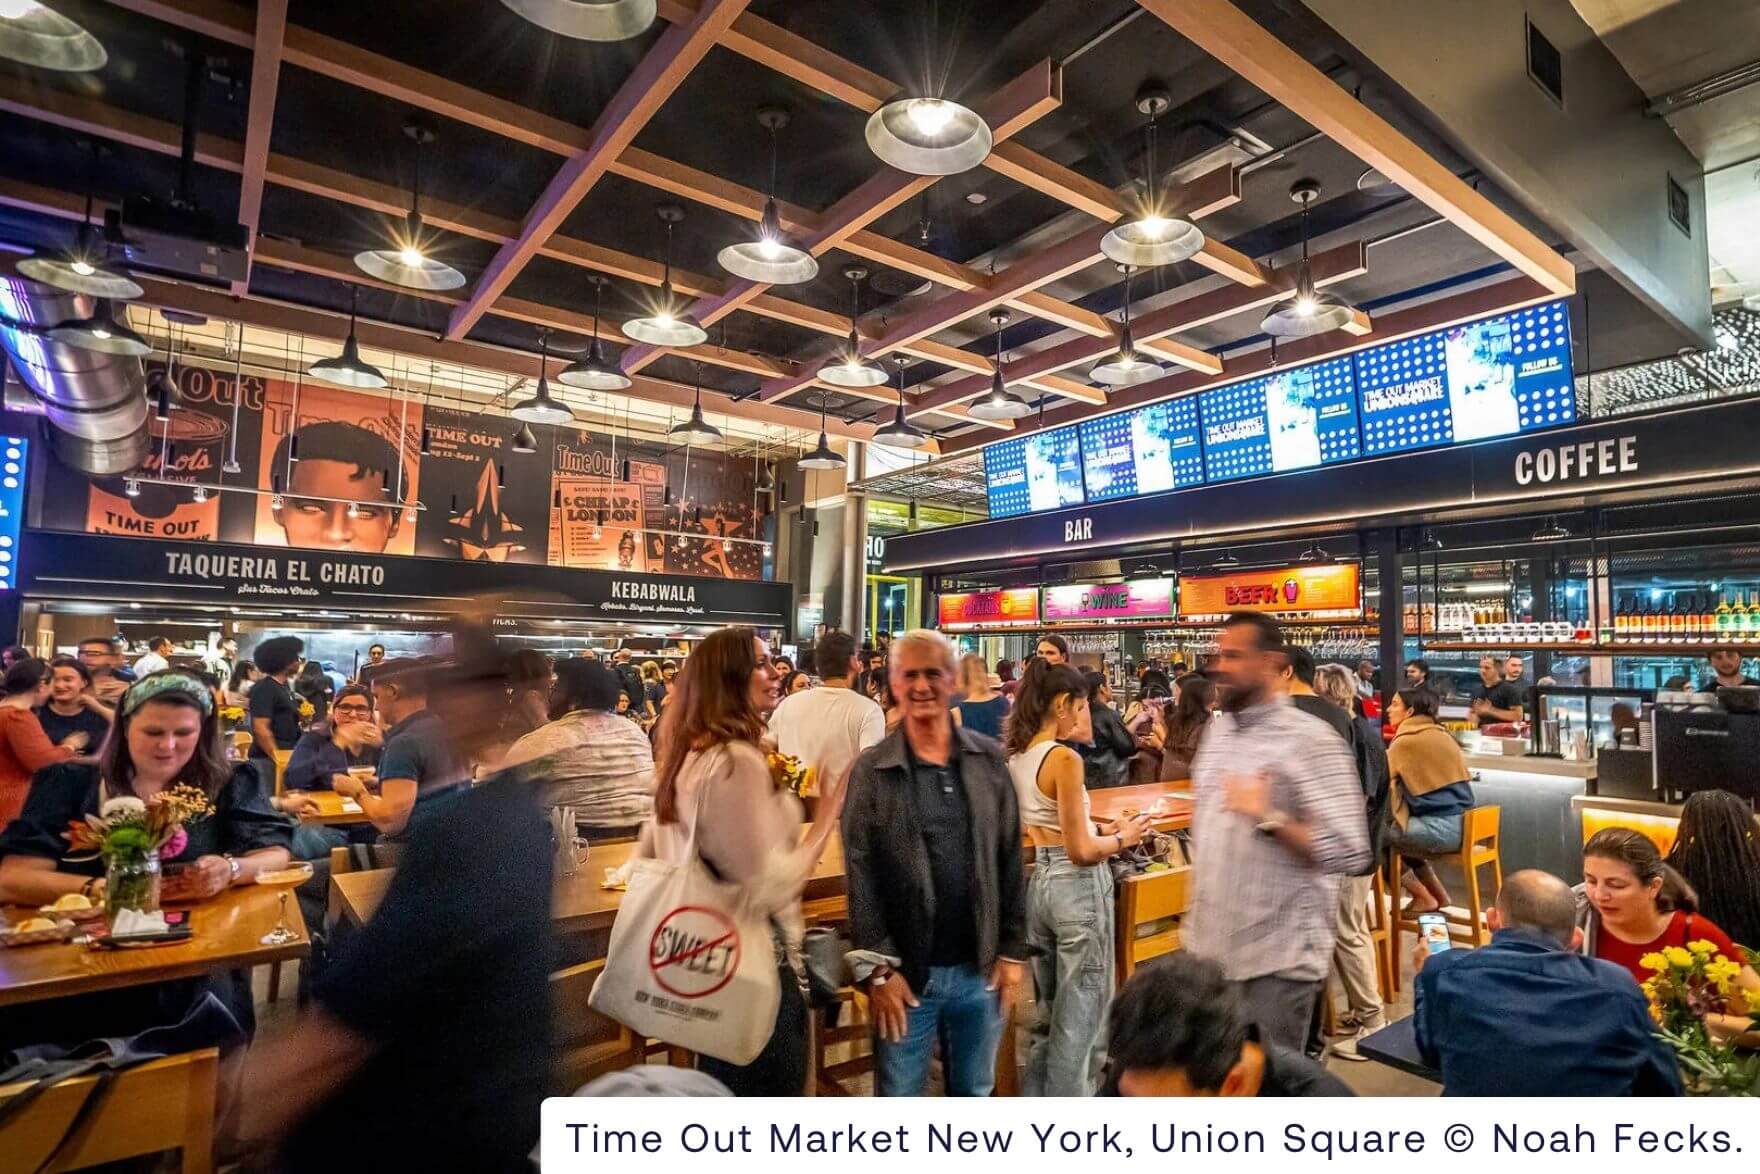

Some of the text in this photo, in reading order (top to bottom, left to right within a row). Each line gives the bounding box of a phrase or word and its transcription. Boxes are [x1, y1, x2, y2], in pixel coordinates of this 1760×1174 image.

[425, 427, 467, 443] TIME
[470, 434, 503, 448] OUT
[557, 444, 592, 474] Time
[592, 450, 620, 477] Out
[1515, 436, 1638, 485] COFFEE
[574, 496, 630, 509] CHEAP
[105, 512, 155, 534] TIME
[163, 520, 200, 536] OUT
[567, 509, 637, 522] LONDON
[1065, 518, 1092, 542] BAR
[166, 552, 385, 585] TAQUERIA EL CHATO
[612, 582, 695, 602] KEBABWALA
[1092, 592, 1129, 609] WINE
[656, 926, 734, 978] SWEET
